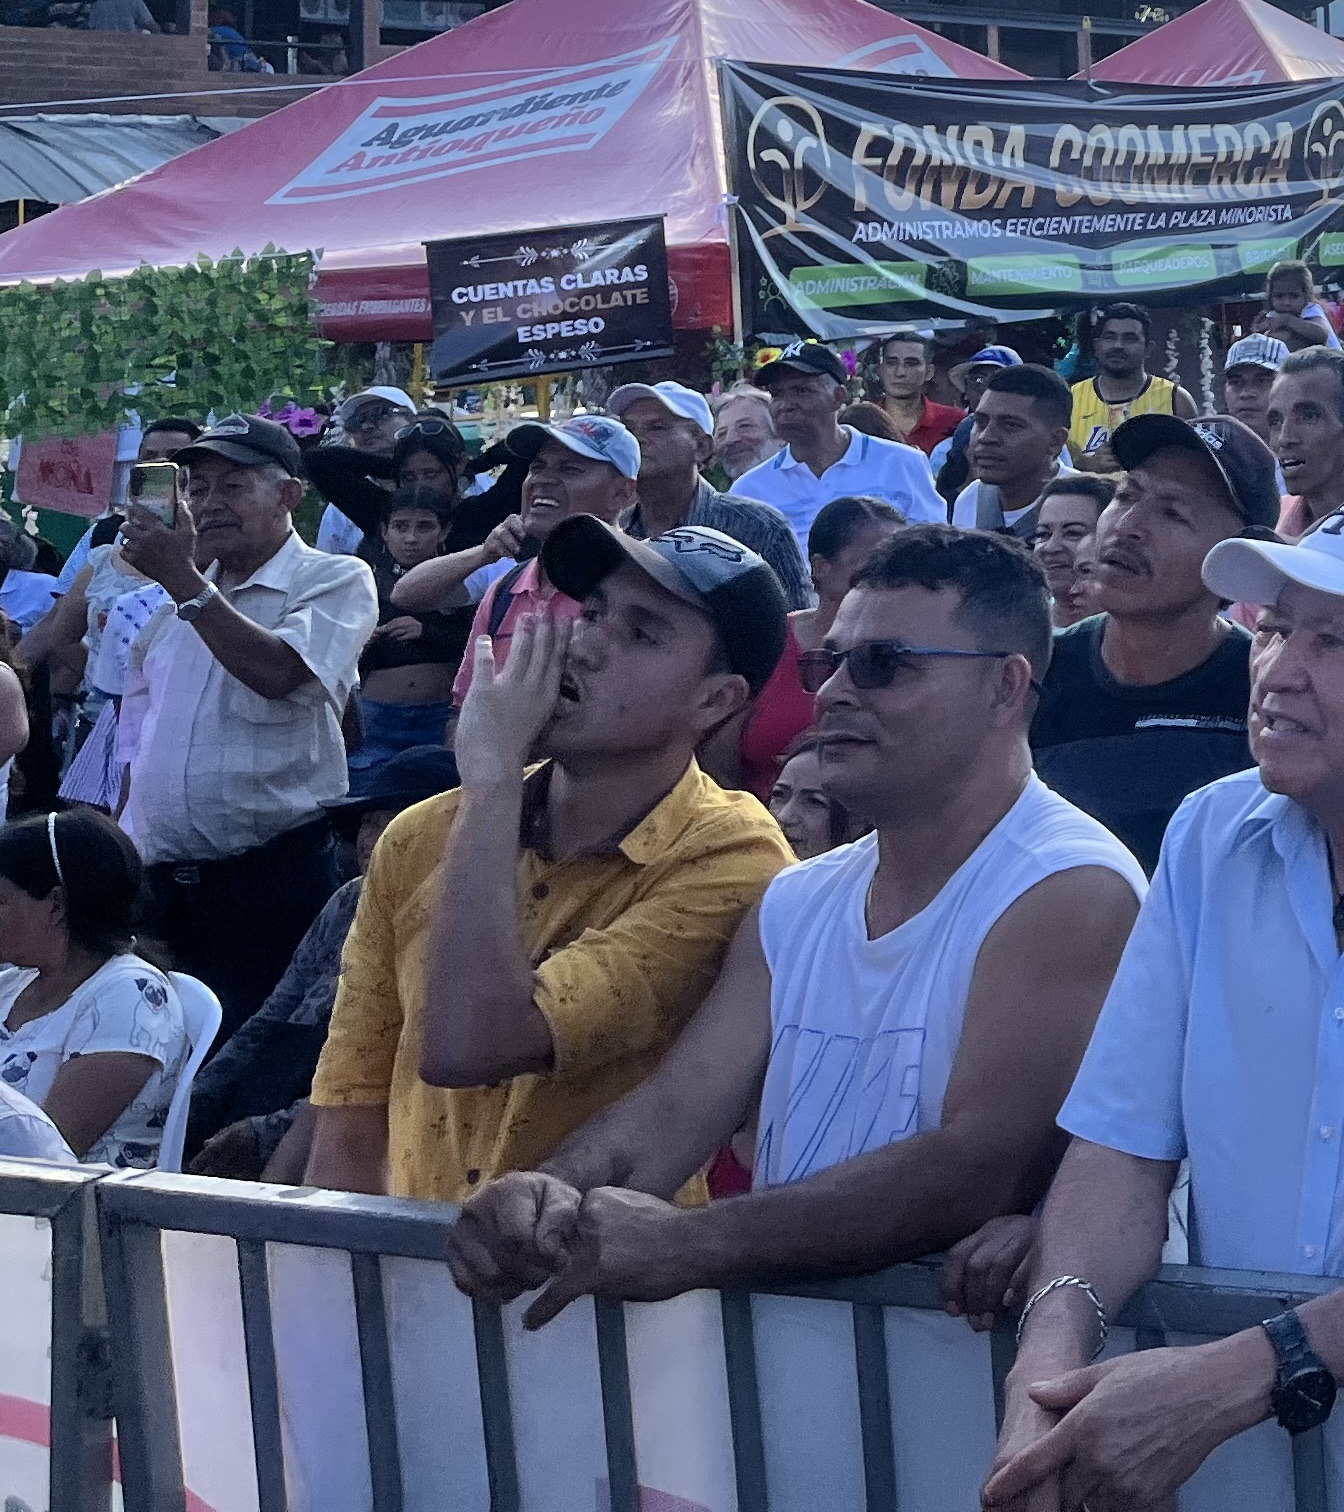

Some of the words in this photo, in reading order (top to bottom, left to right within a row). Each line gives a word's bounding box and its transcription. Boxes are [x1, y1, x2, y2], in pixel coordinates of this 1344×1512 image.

[360, 78, 632, 150] Aguardiente
[324, 105, 608, 176] Antioqueño
[852, 121, 1038, 213] FONDA
[1049, 121, 1295, 208] COOMERCA
[852, 220, 1002, 245] ADMINISTRAMOS
[1004, 210, 1146, 238] EFICIENTEMENTE
[1149, 211, 1166, 230] LA
[1169, 210, 1217, 227] PLAZA
[1219, 203, 1293, 224] MINORISTA
[451, 276, 556, 306] CUENTAS
[559, 265, 649, 291] CLARAS
[459, 310, 476, 327] Y
[482, 305, 511, 325] EL
[515, 288, 650, 320] CHOCOLATE
[516, 316, 606, 344] ESPESO
